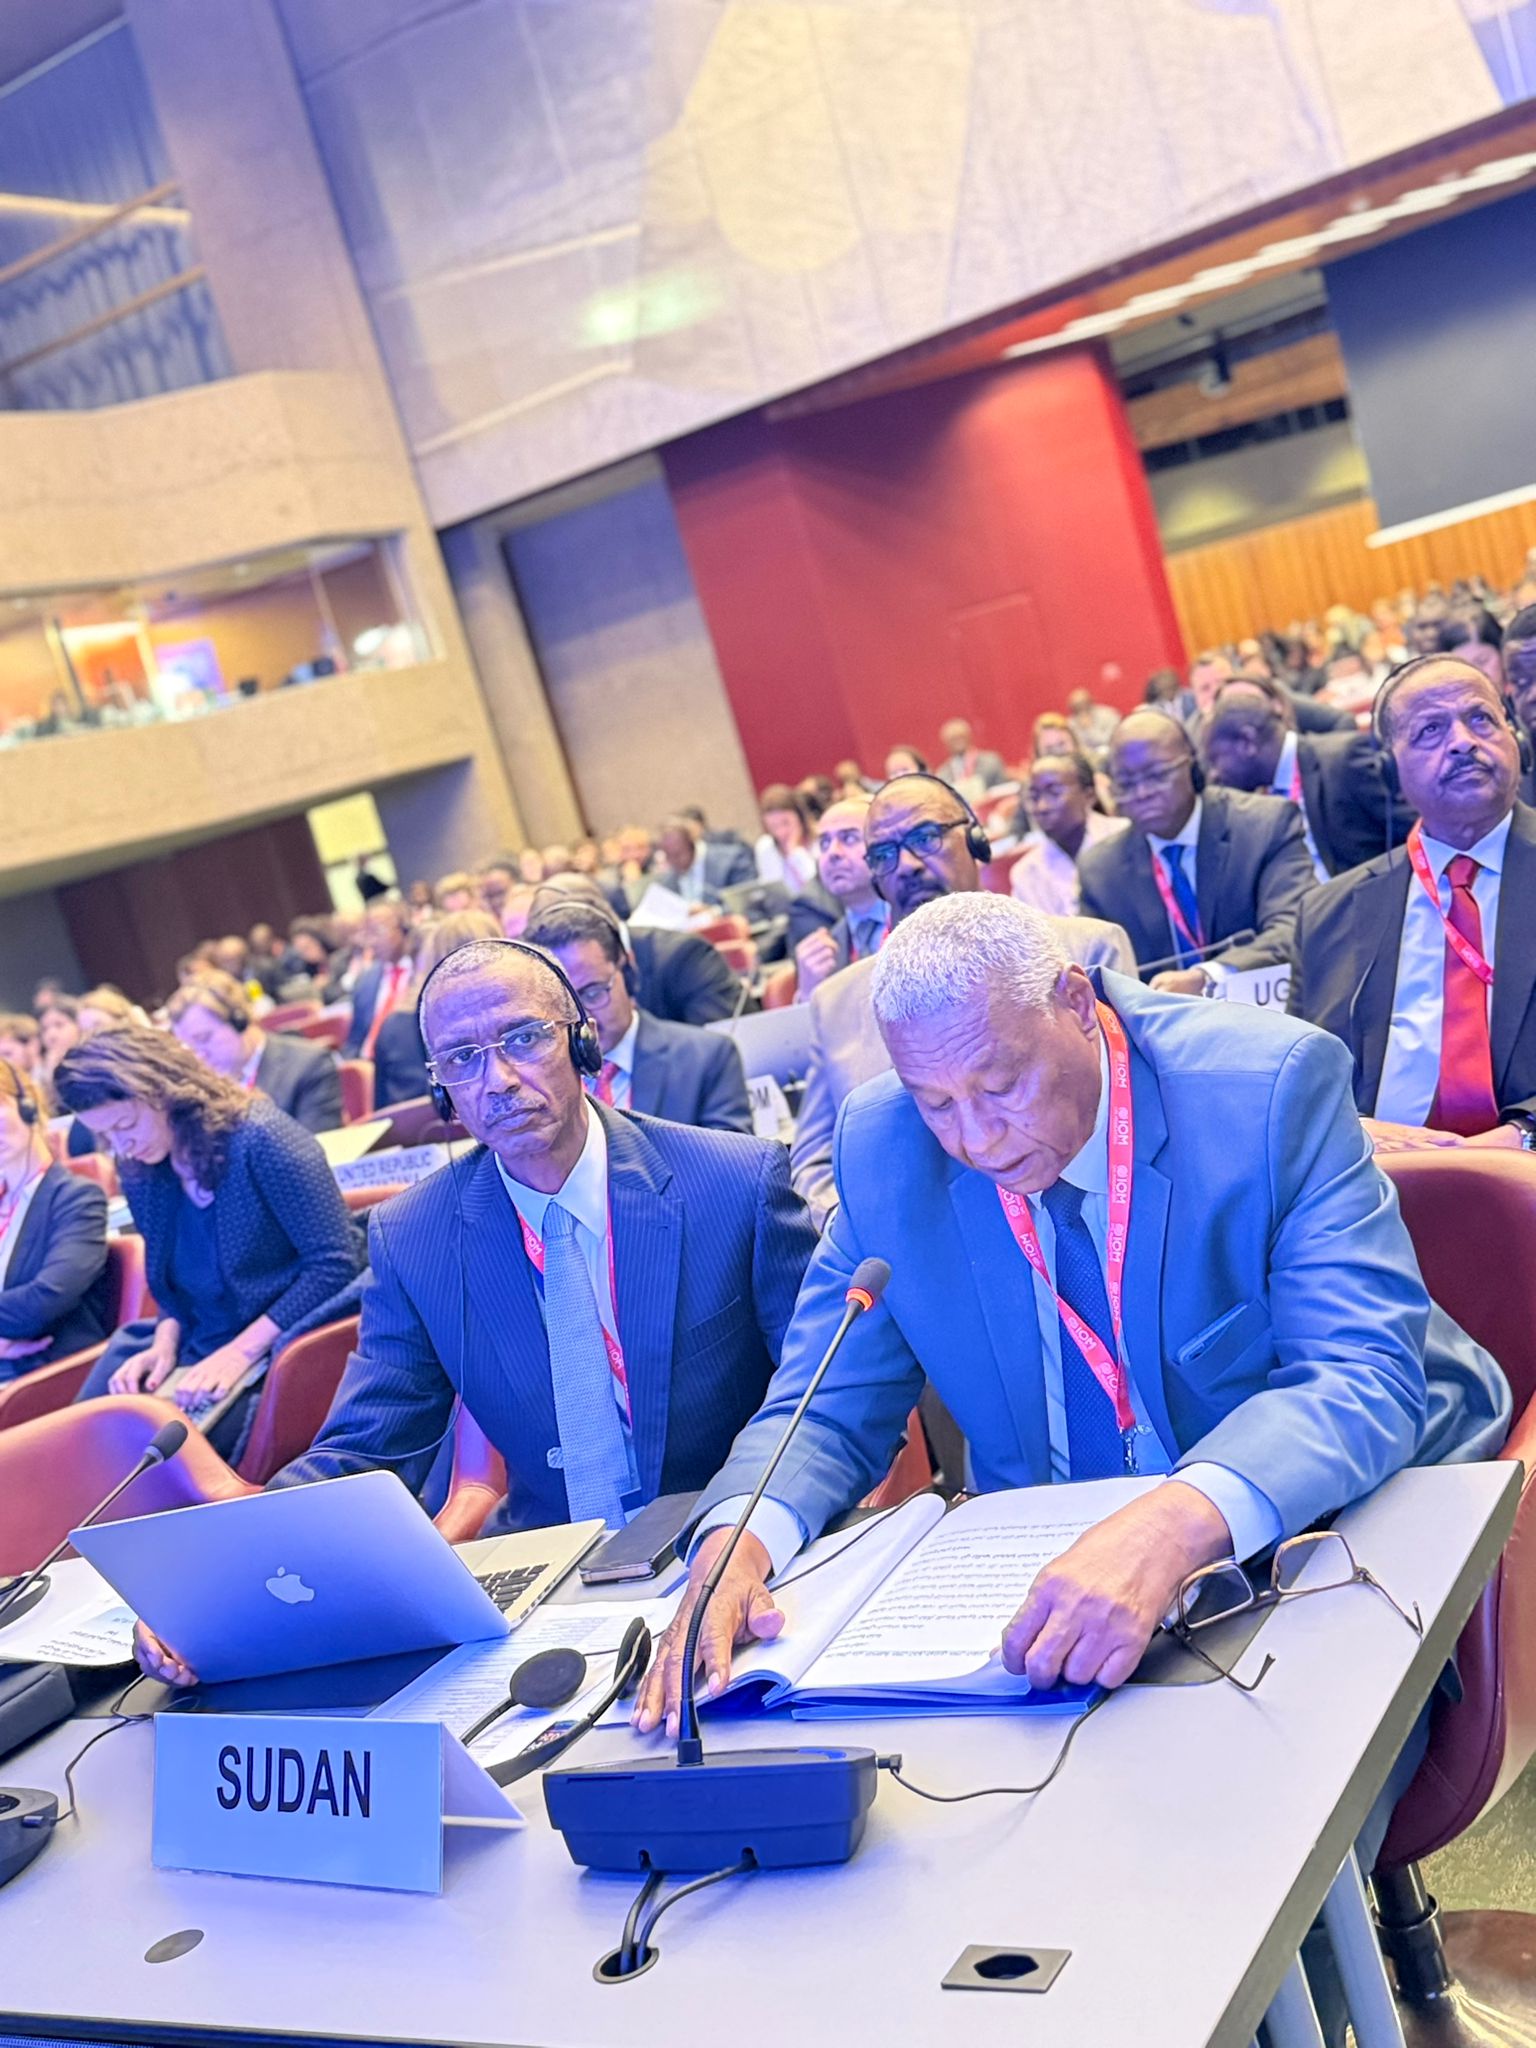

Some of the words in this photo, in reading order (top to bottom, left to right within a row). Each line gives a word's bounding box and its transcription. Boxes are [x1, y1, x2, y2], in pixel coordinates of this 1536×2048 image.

[1117, 1063, 1128, 1089] IOM
[1117, 1122, 1129, 1146] IOM
[1115, 1179, 1128, 1205] IOM
[527, 1233, 543, 1256] IOM
[1019, 1233, 1038, 1260] IOM
[1110, 1236, 1123, 1263] IOM
[1075, 1327, 1097, 1351] IOM
[216, 1745, 371, 1818] SUDAN
